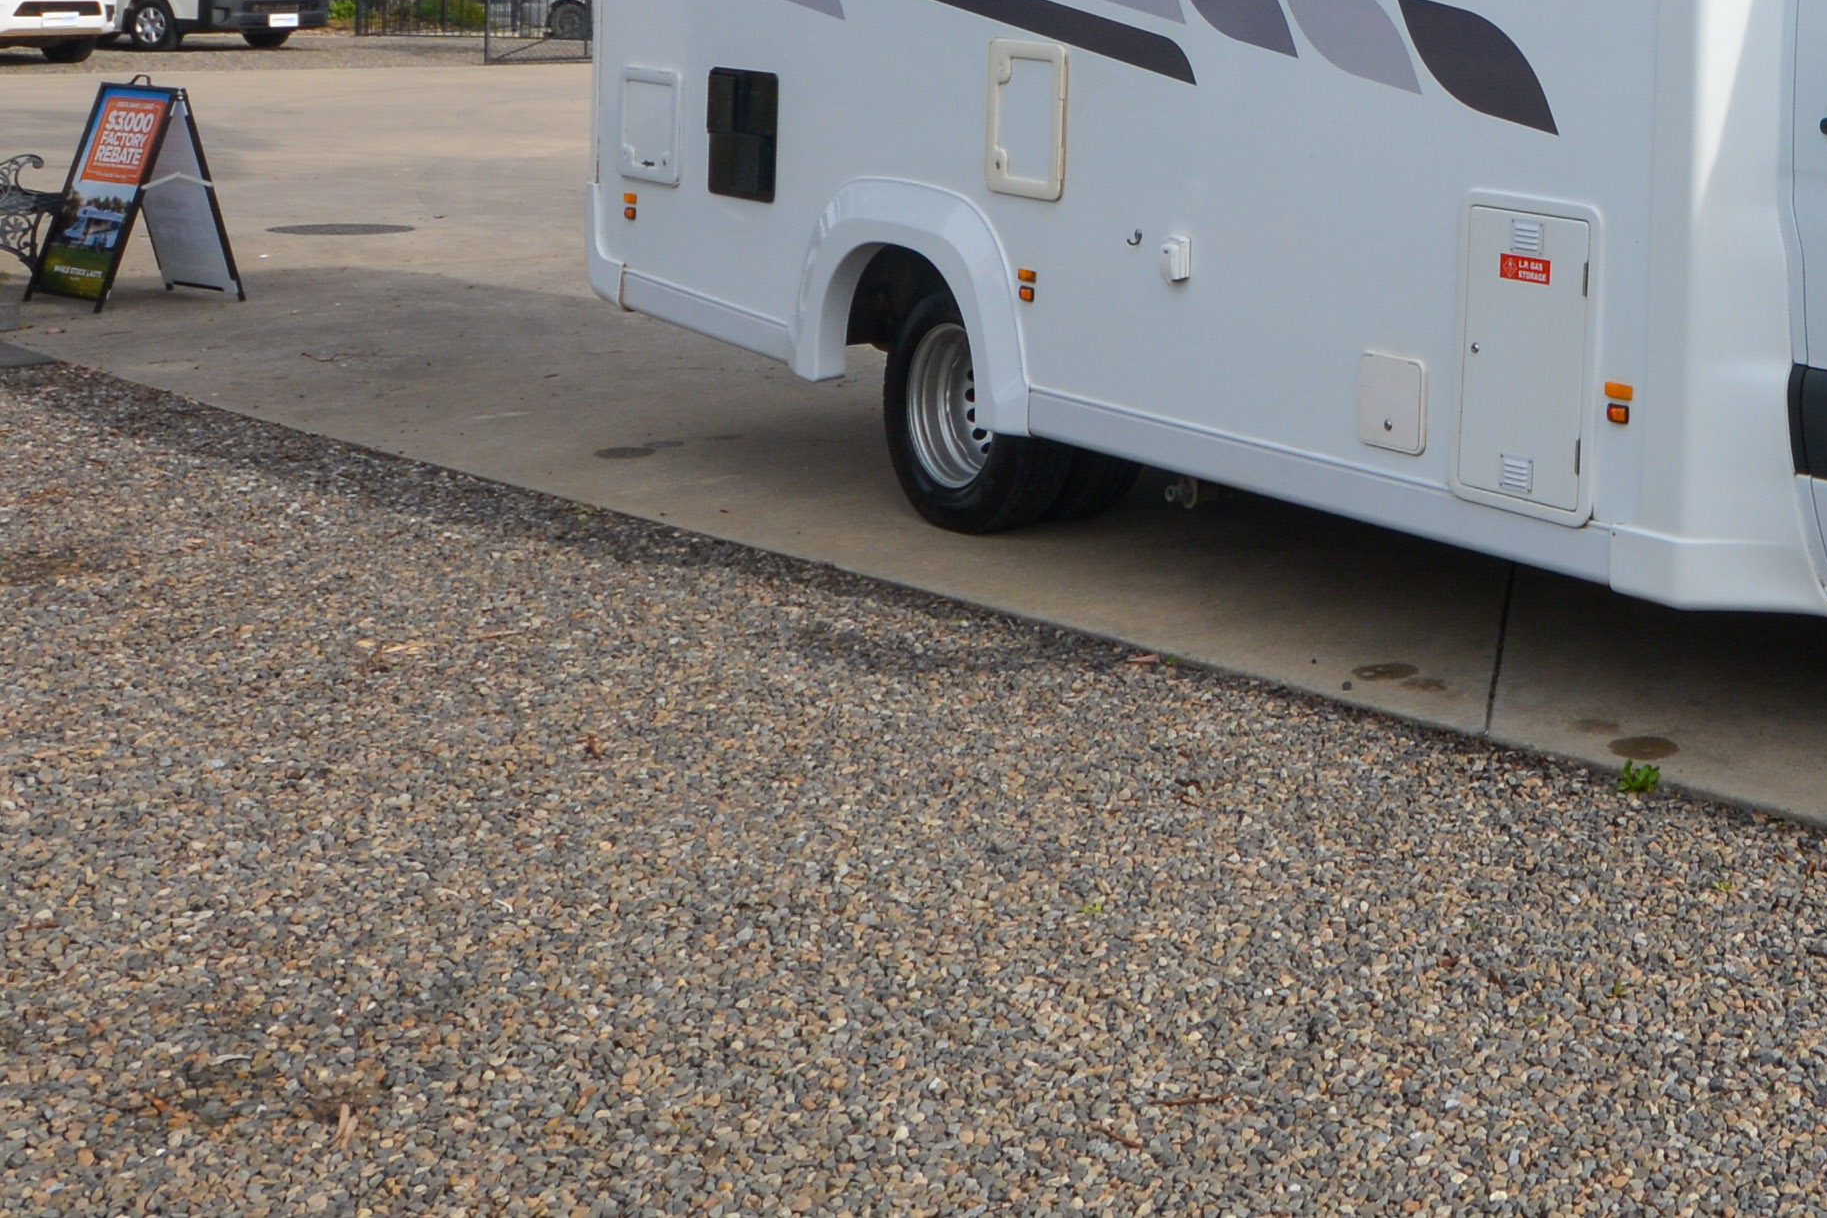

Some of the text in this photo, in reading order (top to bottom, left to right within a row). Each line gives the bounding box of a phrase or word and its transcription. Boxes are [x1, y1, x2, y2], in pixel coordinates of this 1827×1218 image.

[100, 130, 149, 148] FACTORY
[94, 145, 144, 166] REBATE
[1530, 262, 1543, 271] GAS
[1518, 270, 1547, 282] STORAGE
